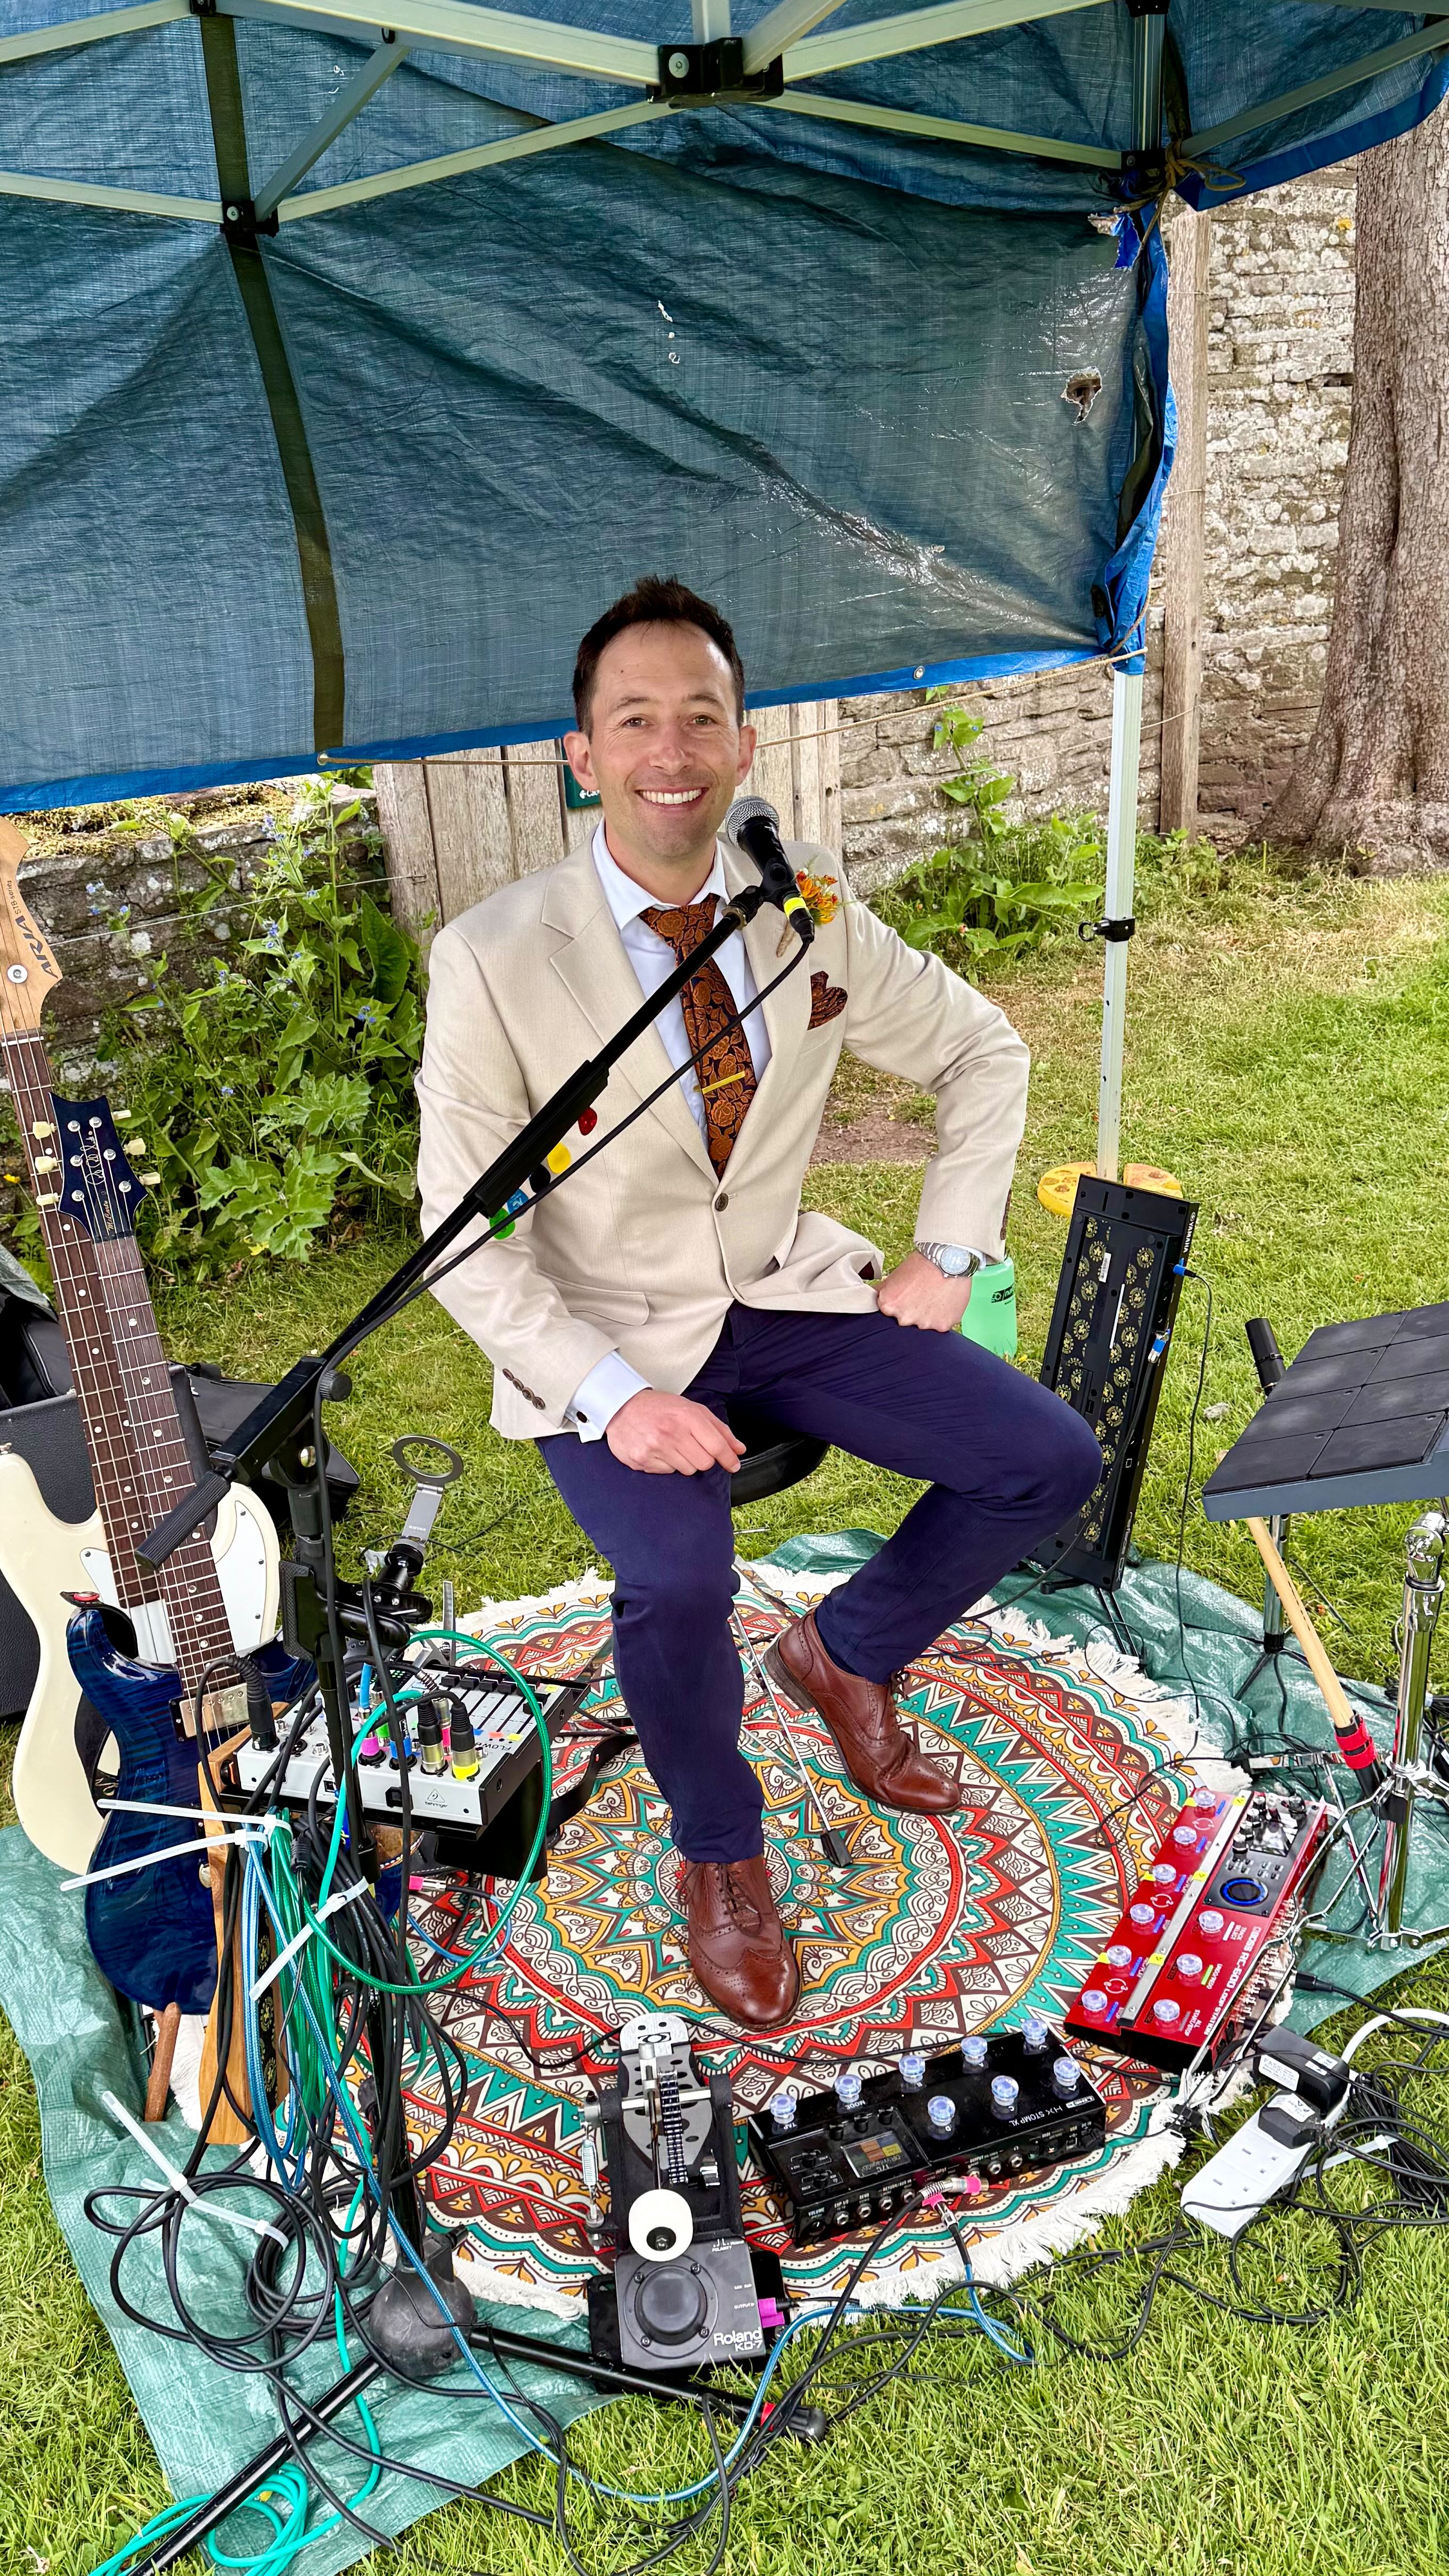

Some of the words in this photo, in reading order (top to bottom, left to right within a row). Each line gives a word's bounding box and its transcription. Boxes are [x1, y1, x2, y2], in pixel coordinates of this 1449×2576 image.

[15, 915, 59, 979] ARIA
[1183, 1221, 1194, 1253] YAMAHA
[1244, 1929, 1260, 1952] BOSS
[1226, 1952, 1249, 1989] RC-600
[1219, 1988, 1231, 2007] LOOP
[844, 2099, 866, 2110] MODE
[1045, 2105, 1063, 2116] HX
[1020, 2111, 1045, 2124] STOMP
[713, 2326, 763, 2346] Roland
[735, 2339, 763, 2352] KD-7
